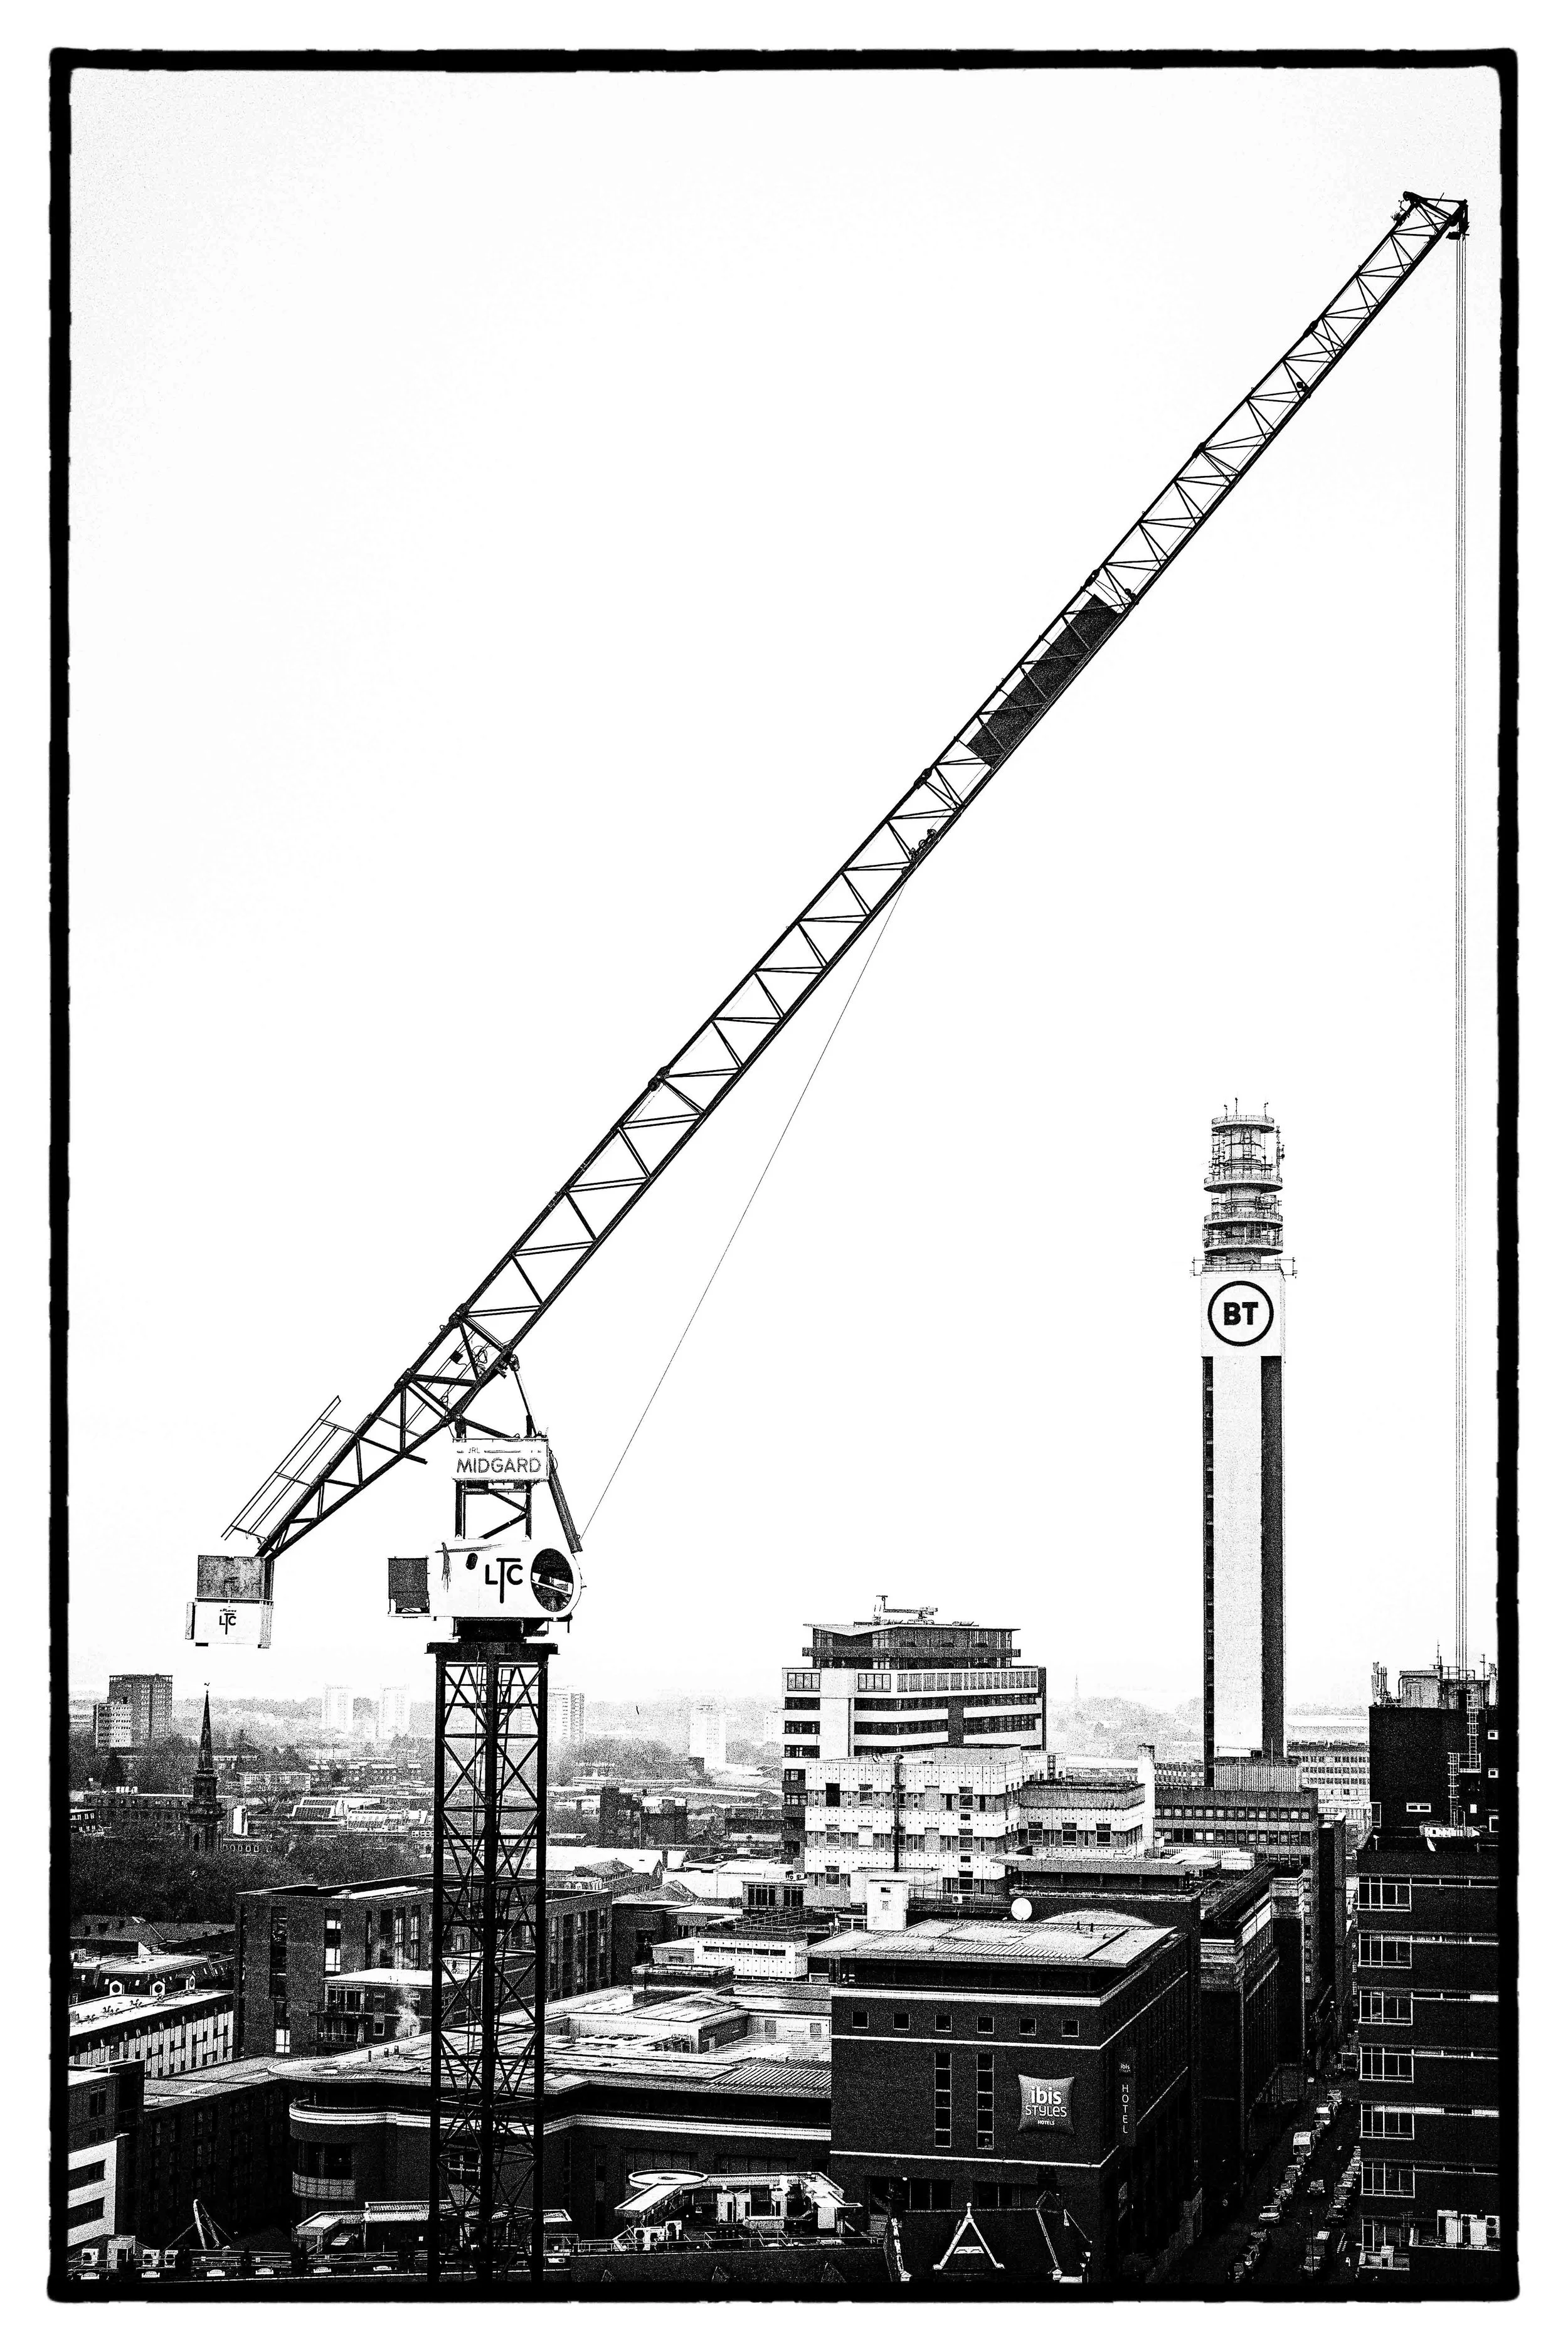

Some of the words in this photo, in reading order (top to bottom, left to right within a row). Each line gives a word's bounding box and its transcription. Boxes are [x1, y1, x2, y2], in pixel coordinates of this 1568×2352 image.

[1224, 1301, 1259, 1325] BT
[457, 1458, 541, 1473] MIDGARD
[485, 1557, 523, 1604] LTC
[219, 1613, 236, 1634] LTC
[1030, 2086, 1062, 2105] ibis
